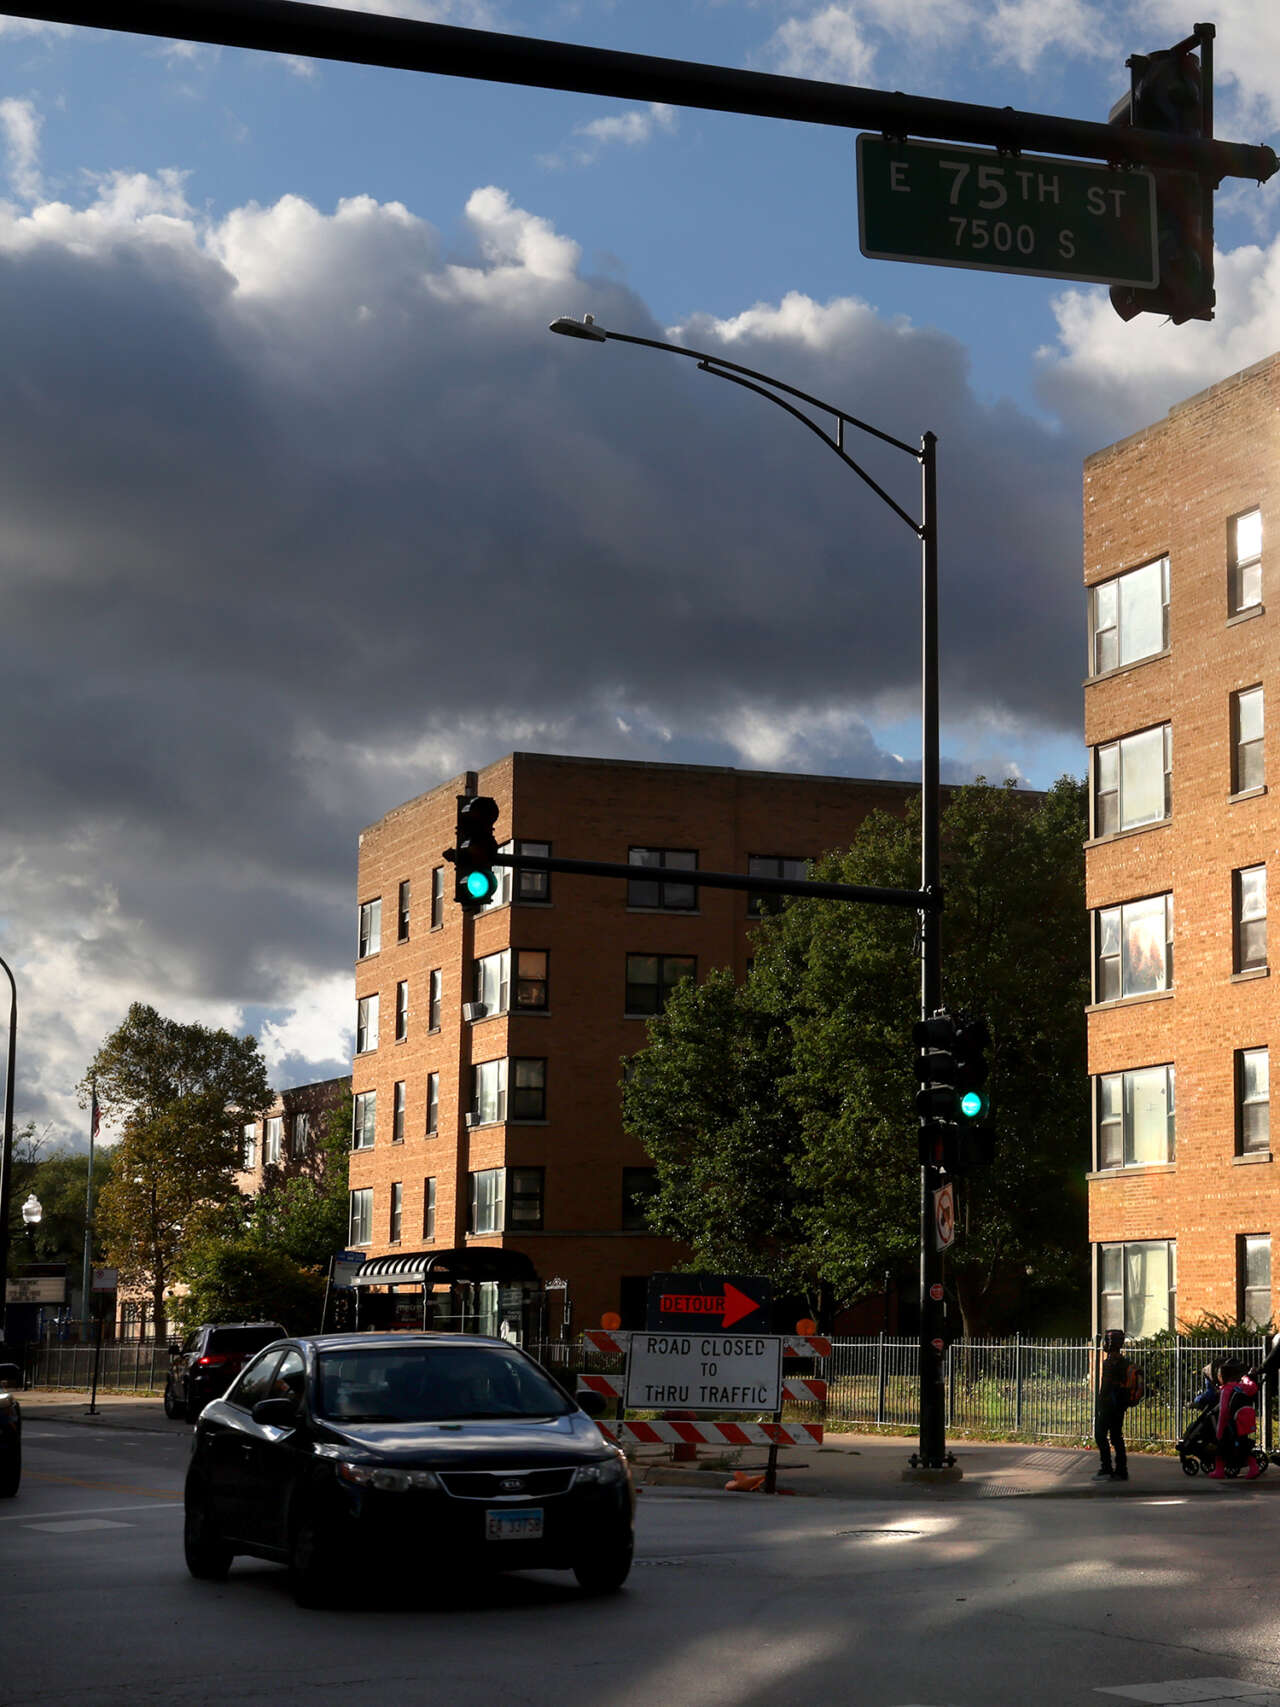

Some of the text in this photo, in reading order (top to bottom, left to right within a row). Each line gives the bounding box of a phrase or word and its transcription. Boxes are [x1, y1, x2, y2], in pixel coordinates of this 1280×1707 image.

[890, 160, 1127, 218] E 75TH ST
[948, 217, 1076, 259] 7500 S
[663, 1296, 725, 1313] DETOUR
[647, 1338, 765, 1357] ROAD CLOSED
[700, 1362, 718, 1377] TO
[645, 1384, 768, 1404] THRU TRAFFIC
